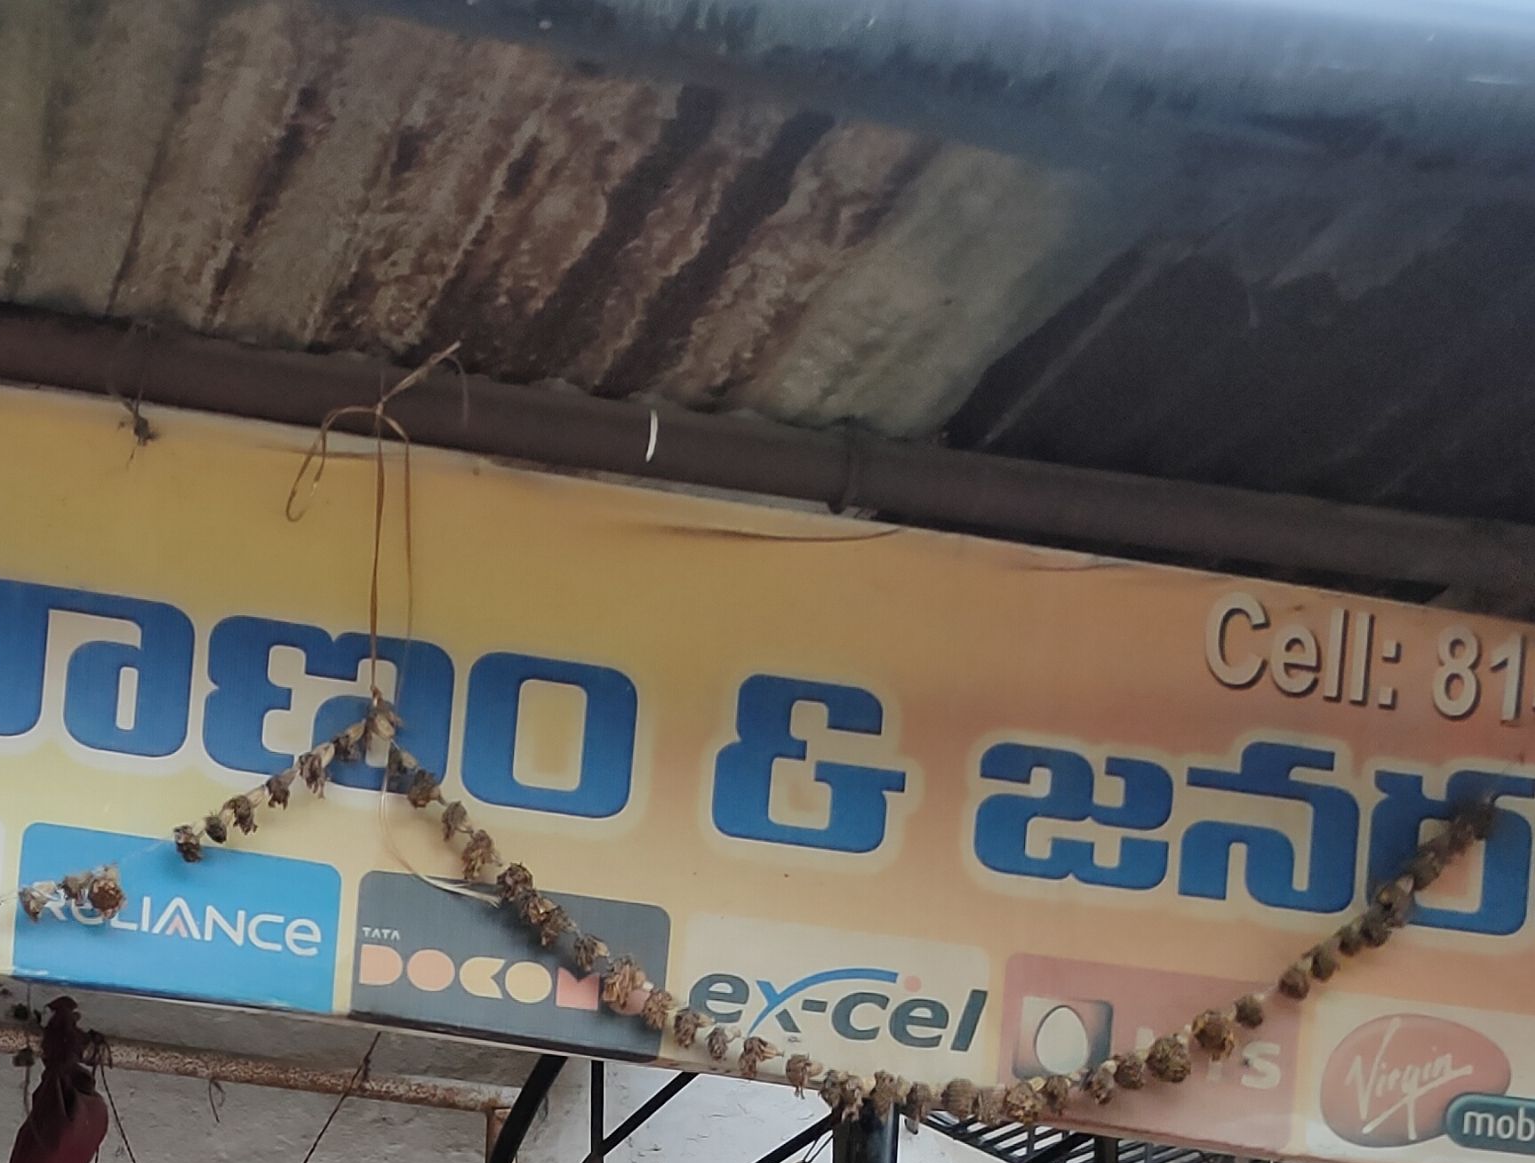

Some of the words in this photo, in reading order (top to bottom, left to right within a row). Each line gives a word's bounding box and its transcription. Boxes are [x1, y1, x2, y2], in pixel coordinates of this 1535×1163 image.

[1205, 591, 1401, 710] Cell:
[1433, 624, 1535, 724] 81
[712, 674, 905, 853] &
[362, 926, 401, 941] TATA
[1347, 1016, 1474, 1140] Virgin
